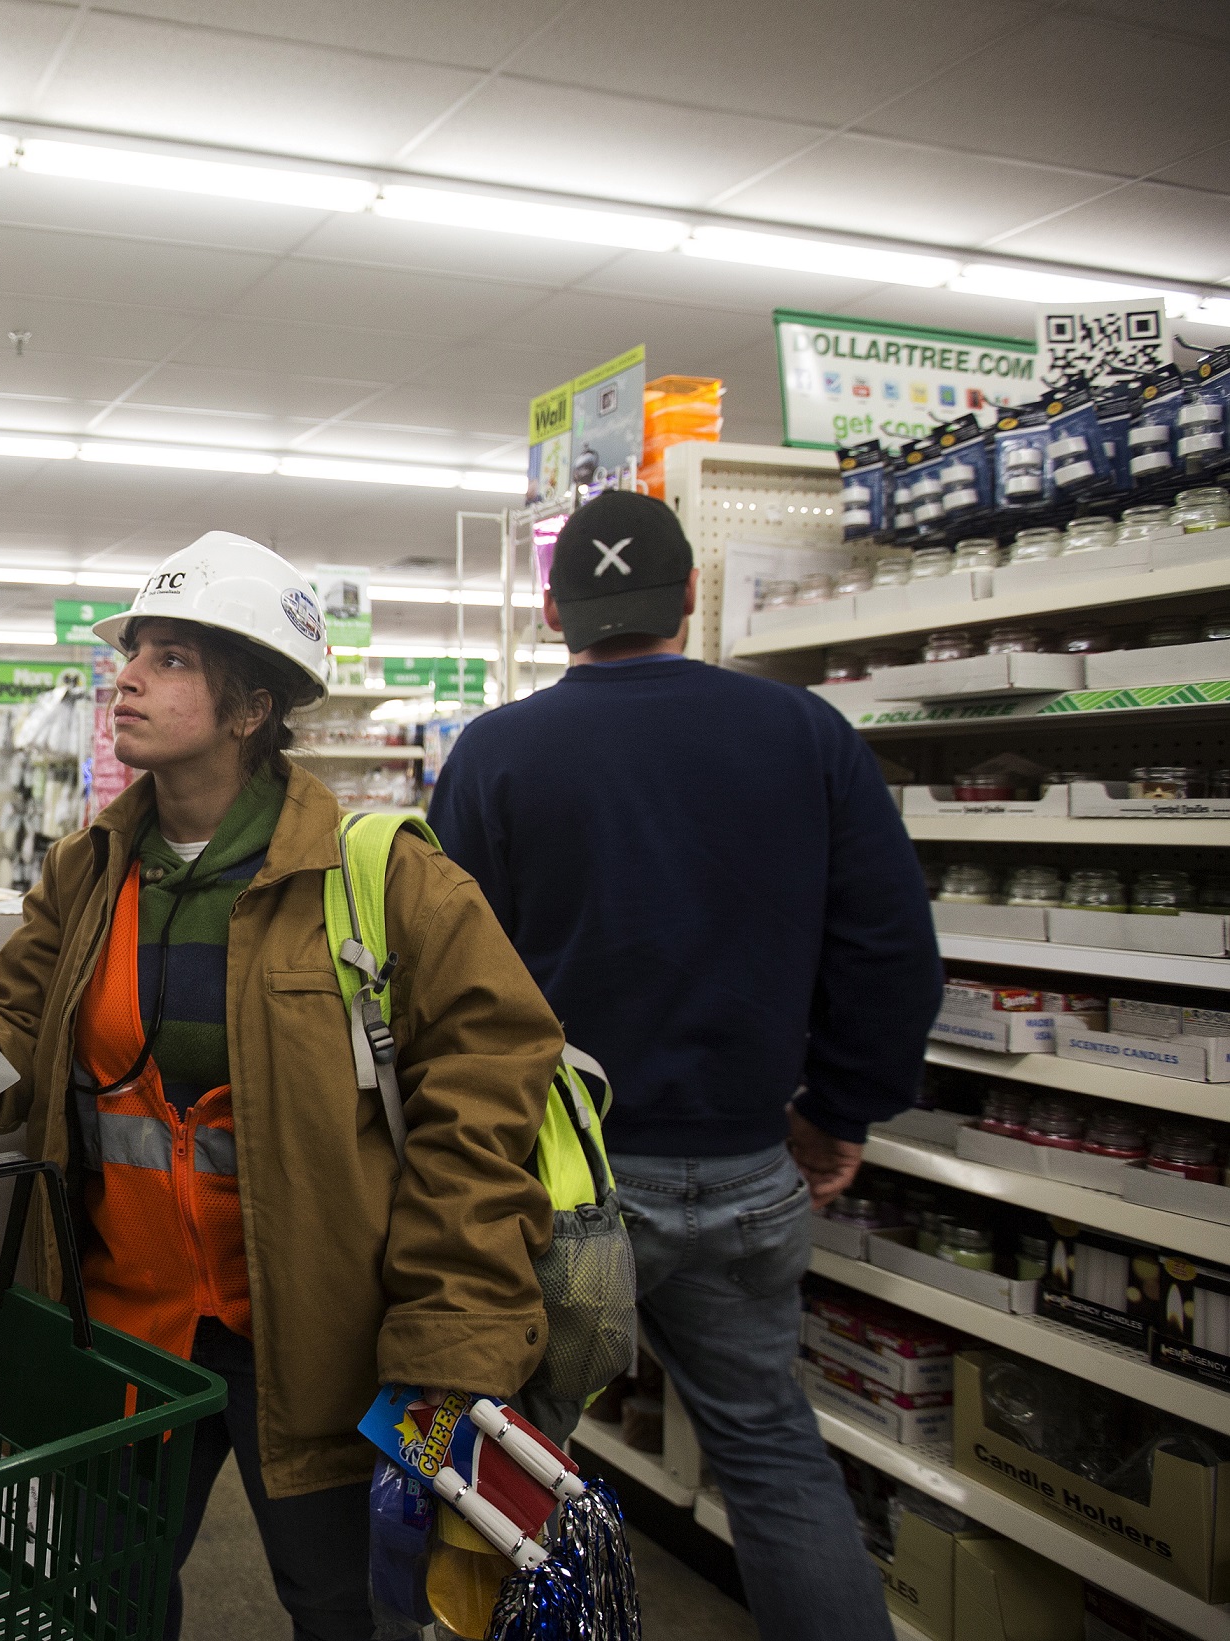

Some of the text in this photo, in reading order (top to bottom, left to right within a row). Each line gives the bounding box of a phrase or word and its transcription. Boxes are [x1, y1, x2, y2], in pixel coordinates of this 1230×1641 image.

[793, 331, 1035, 380] DOLLARTREE.COM
[832, 413, 874, 440] get
[875, 707, 954, 723] DOLLAR
[1070, 1038, 1179, 1065] SCENTED CANDLES
[974, 1441, 1057, 1499] Candle
[1064, 1487, 1172, 1560] Holders
